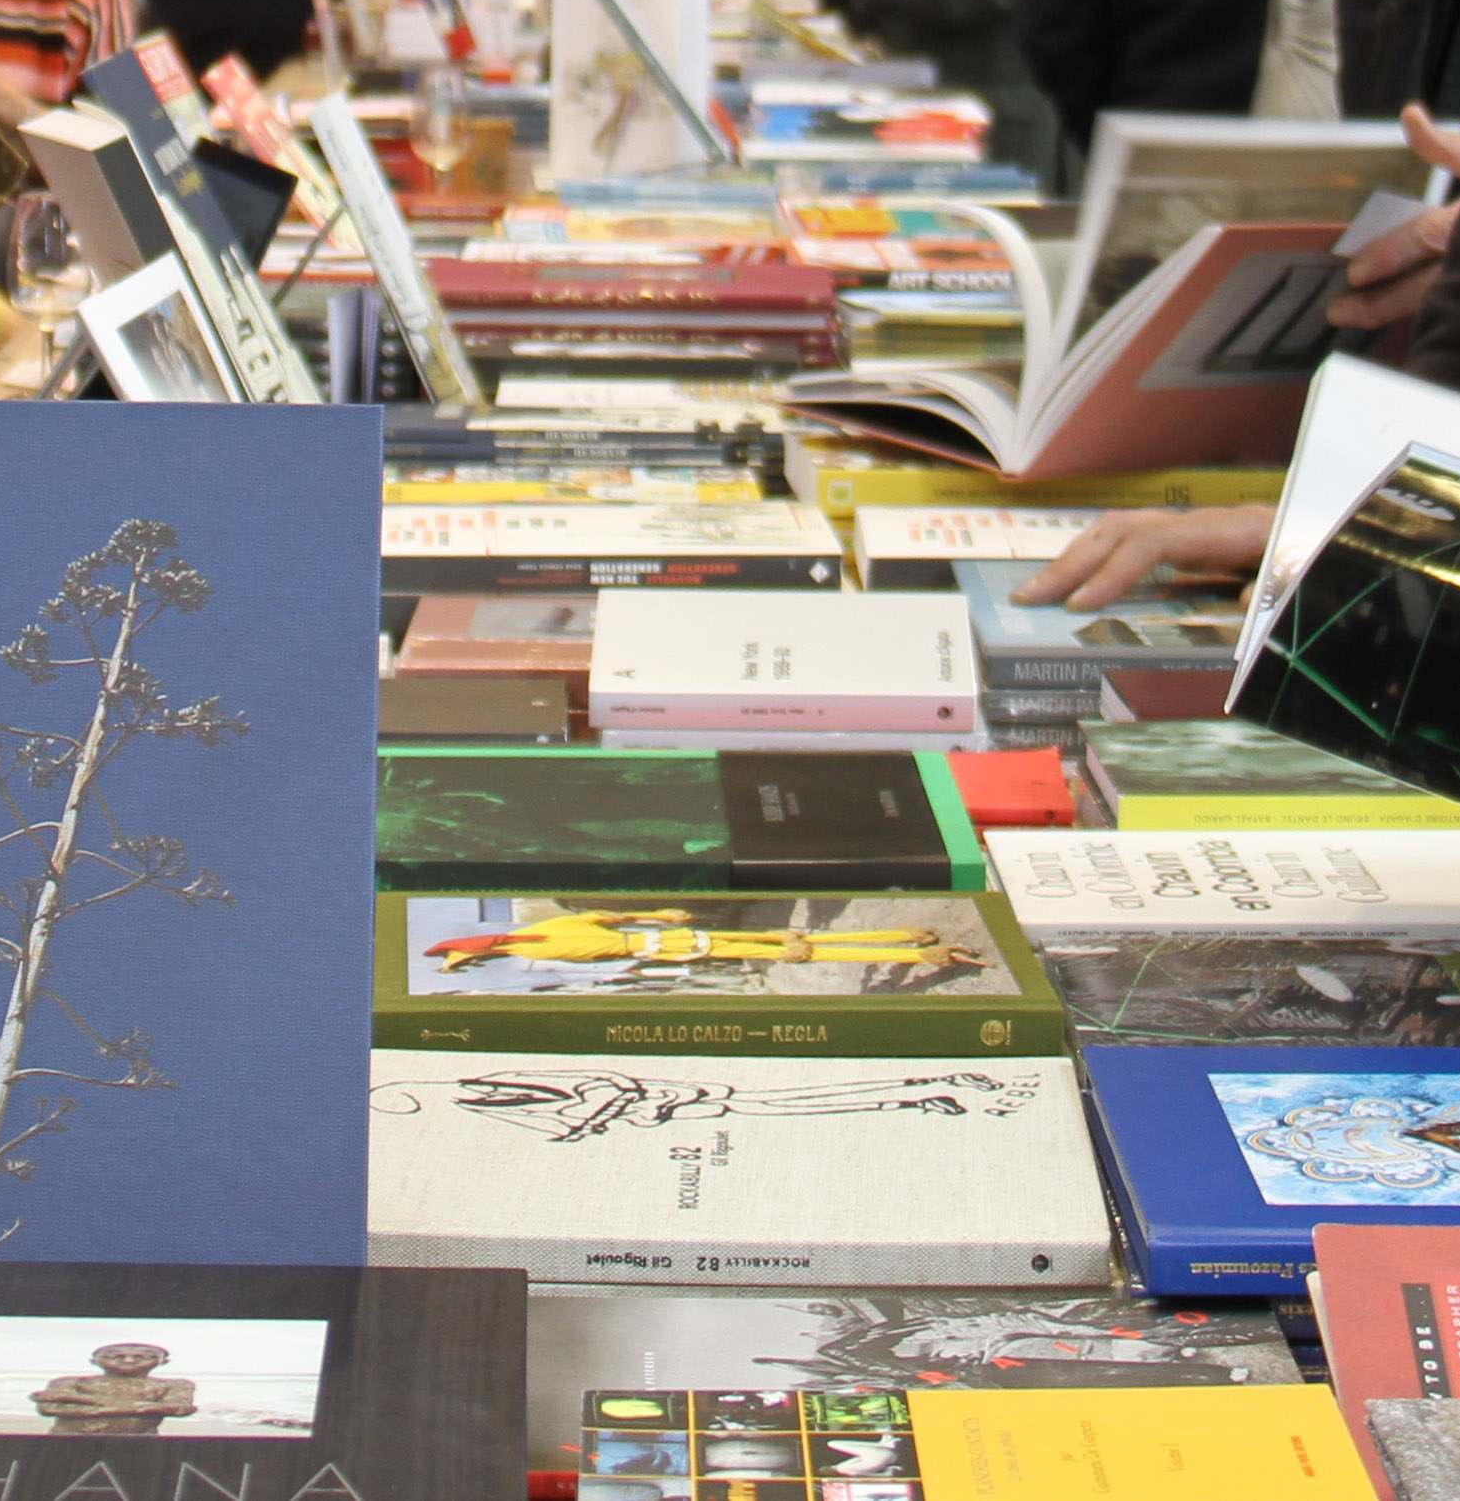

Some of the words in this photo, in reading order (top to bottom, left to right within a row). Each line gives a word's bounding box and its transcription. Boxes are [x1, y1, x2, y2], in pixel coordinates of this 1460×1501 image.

[889, 271, 929, 291] ART
[1014, 662, 1076, 682] MARTIN
[1009, 729, 1073, 746] MARTIN
[1017, 852, 1077, 898] Chauvin
[1137, 852, 1200, 898] Chauvin
[1188, 839, 1259, 895] Colombia
[1257, 852, 1323, 898] Chauvin
[1109, 895, 1145, 910] en
[1230, 896, 1272, 911] en
[668, 1025, 688, 1043] LO
[692, 1025, 742, 1043] CALZO
[772, 1025, 828, 1043] REGLA
[670, 1145, 702, 1161] 82
[711, 1154, 729, 1167] Gil
[679, 1163, 701, 1210] ROCKABILLY
[586, 1254, 647, 1268] Rigoulet
[652, 1254, 672, 1269] Gil
[696, 1255, 720, 1271] 82
[724, 1256, 811, 1269] ROCKABILLY
[1423, 1358, 1440, 1385] TO
